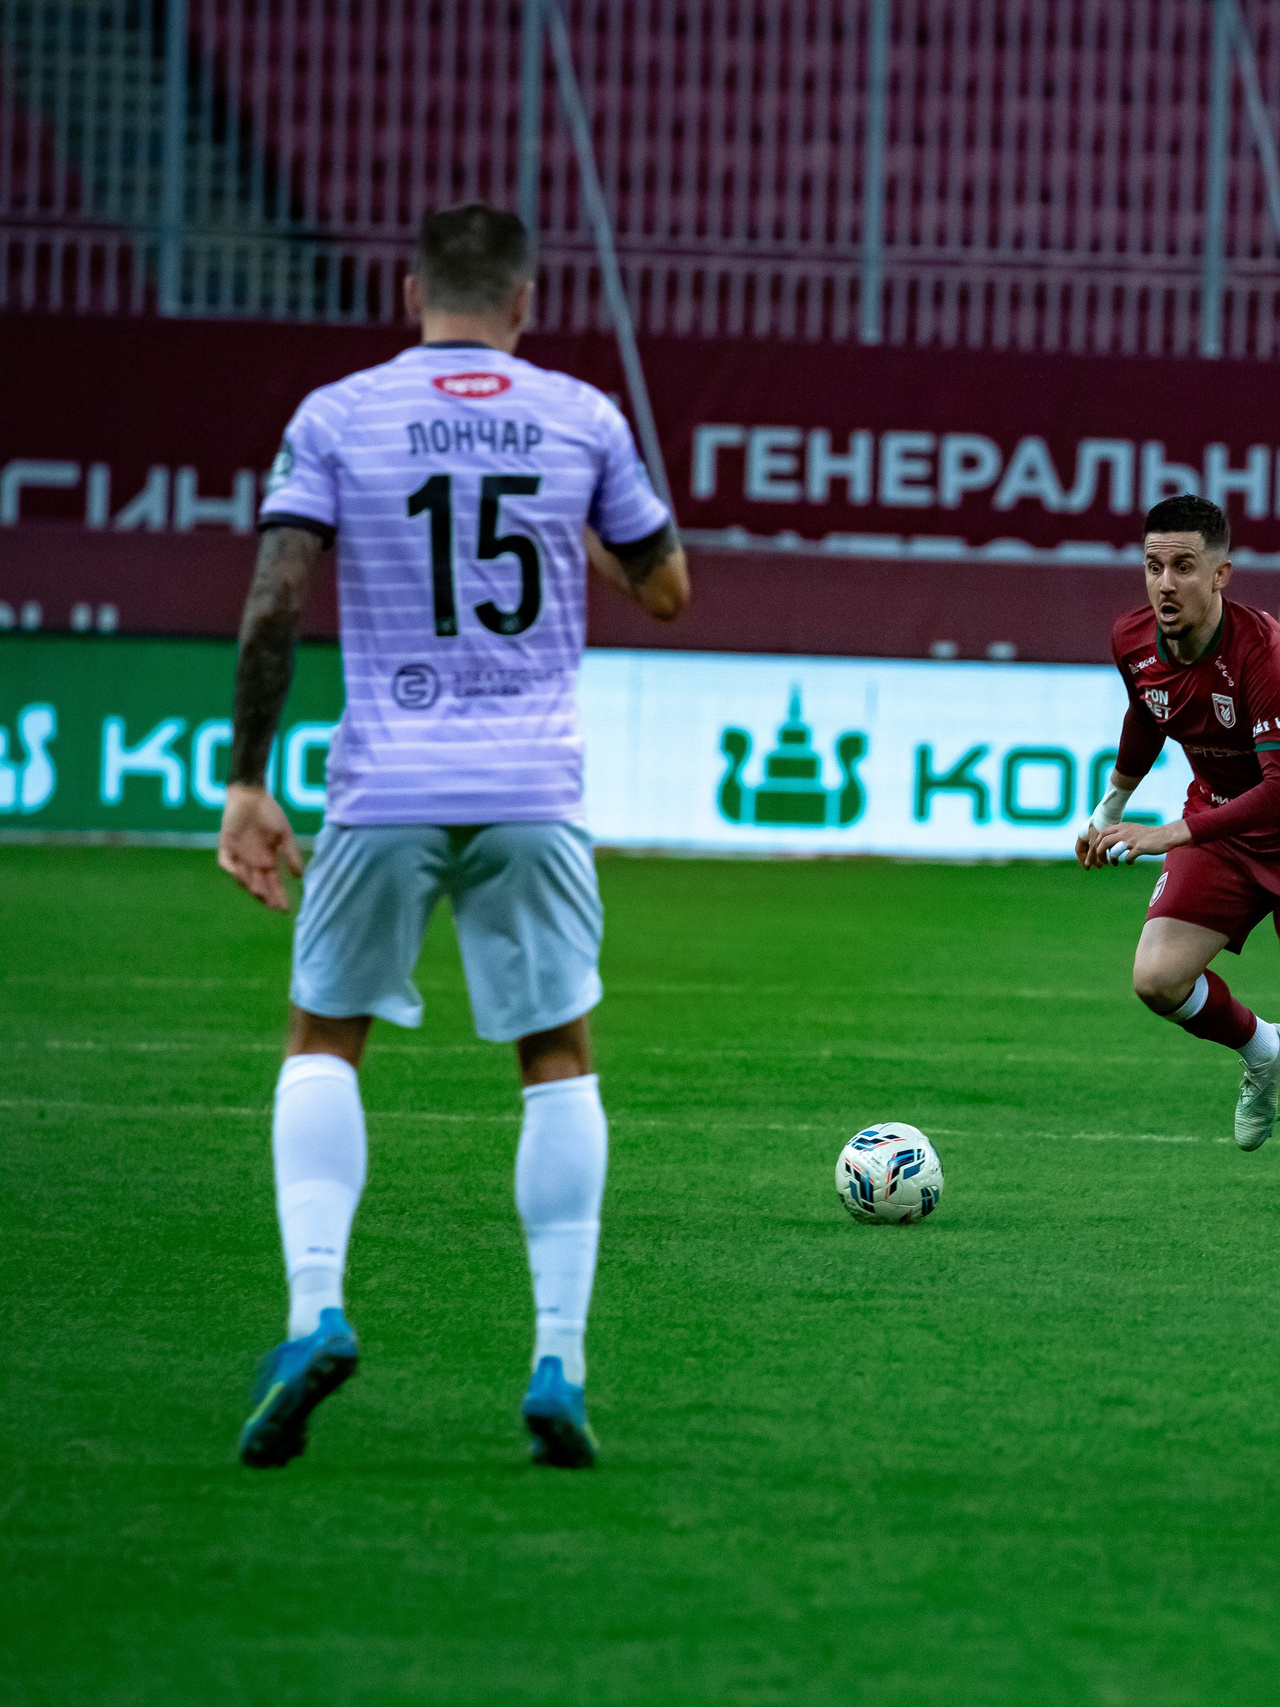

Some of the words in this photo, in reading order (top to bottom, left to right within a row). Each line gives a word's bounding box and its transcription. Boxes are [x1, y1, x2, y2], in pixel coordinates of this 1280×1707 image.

[407, 418, 543, 456] ЛОНЧАР
[407, 474, 543, 638] 15
[1144, 687, 1169, 706] FON
